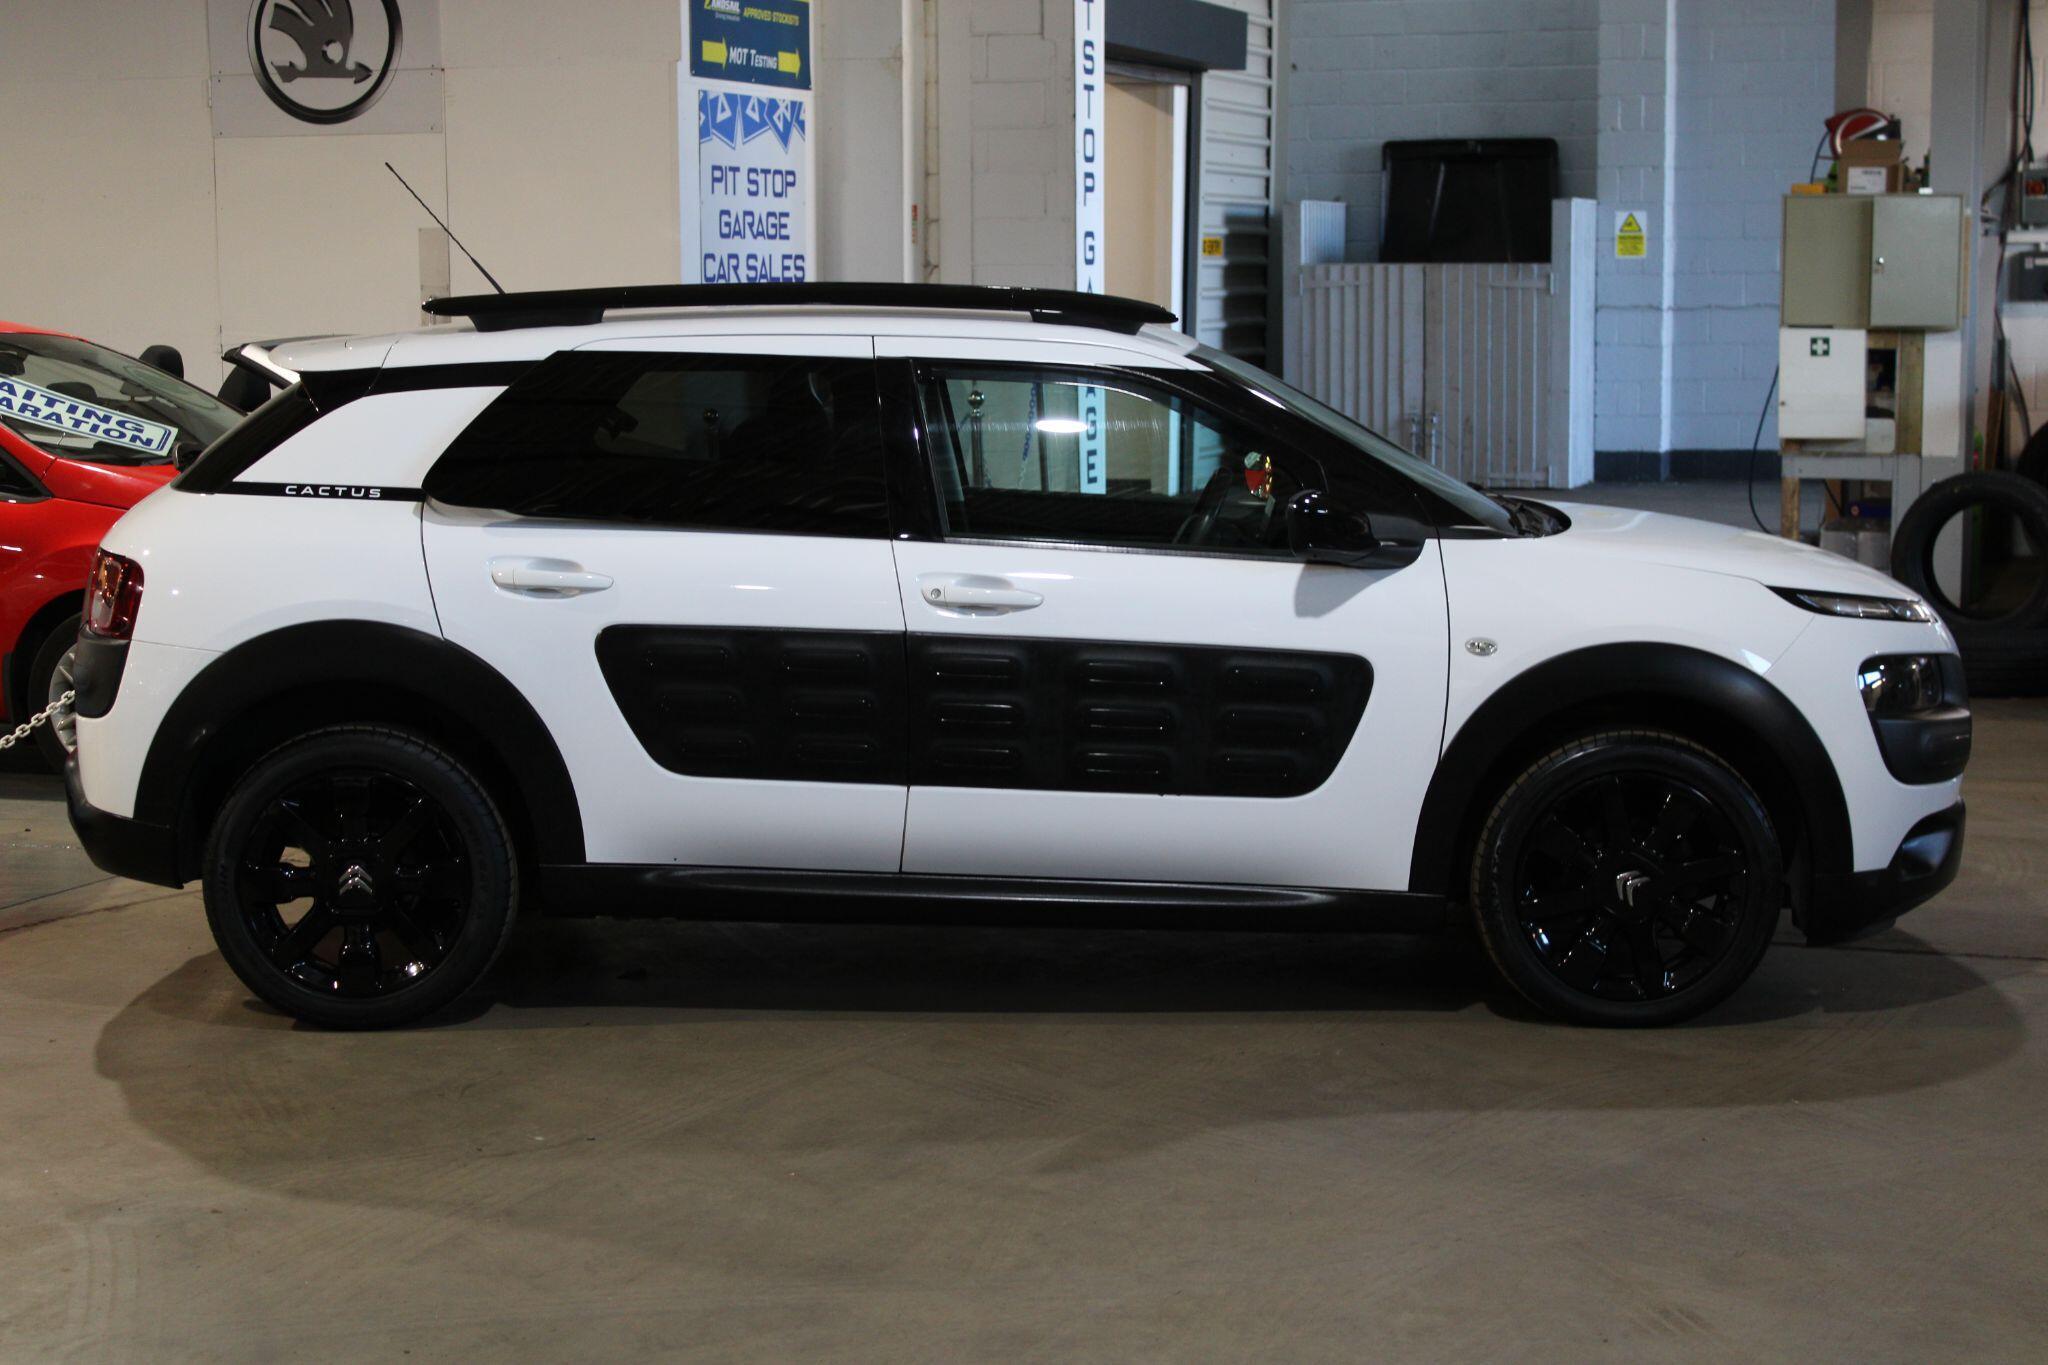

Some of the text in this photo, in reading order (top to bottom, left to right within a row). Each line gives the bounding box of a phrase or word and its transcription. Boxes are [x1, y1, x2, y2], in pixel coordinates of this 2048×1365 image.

[729, 46, 749, 65] MOT
[1083, 40, 1096, 208] STOP
[711, 165, 796, 198] PIT STOP
[719, 209, 790, 240] GARAGE
[703, 253, 806, 284] CAR SALES
[285, 485, 381, 498] CACTUS
